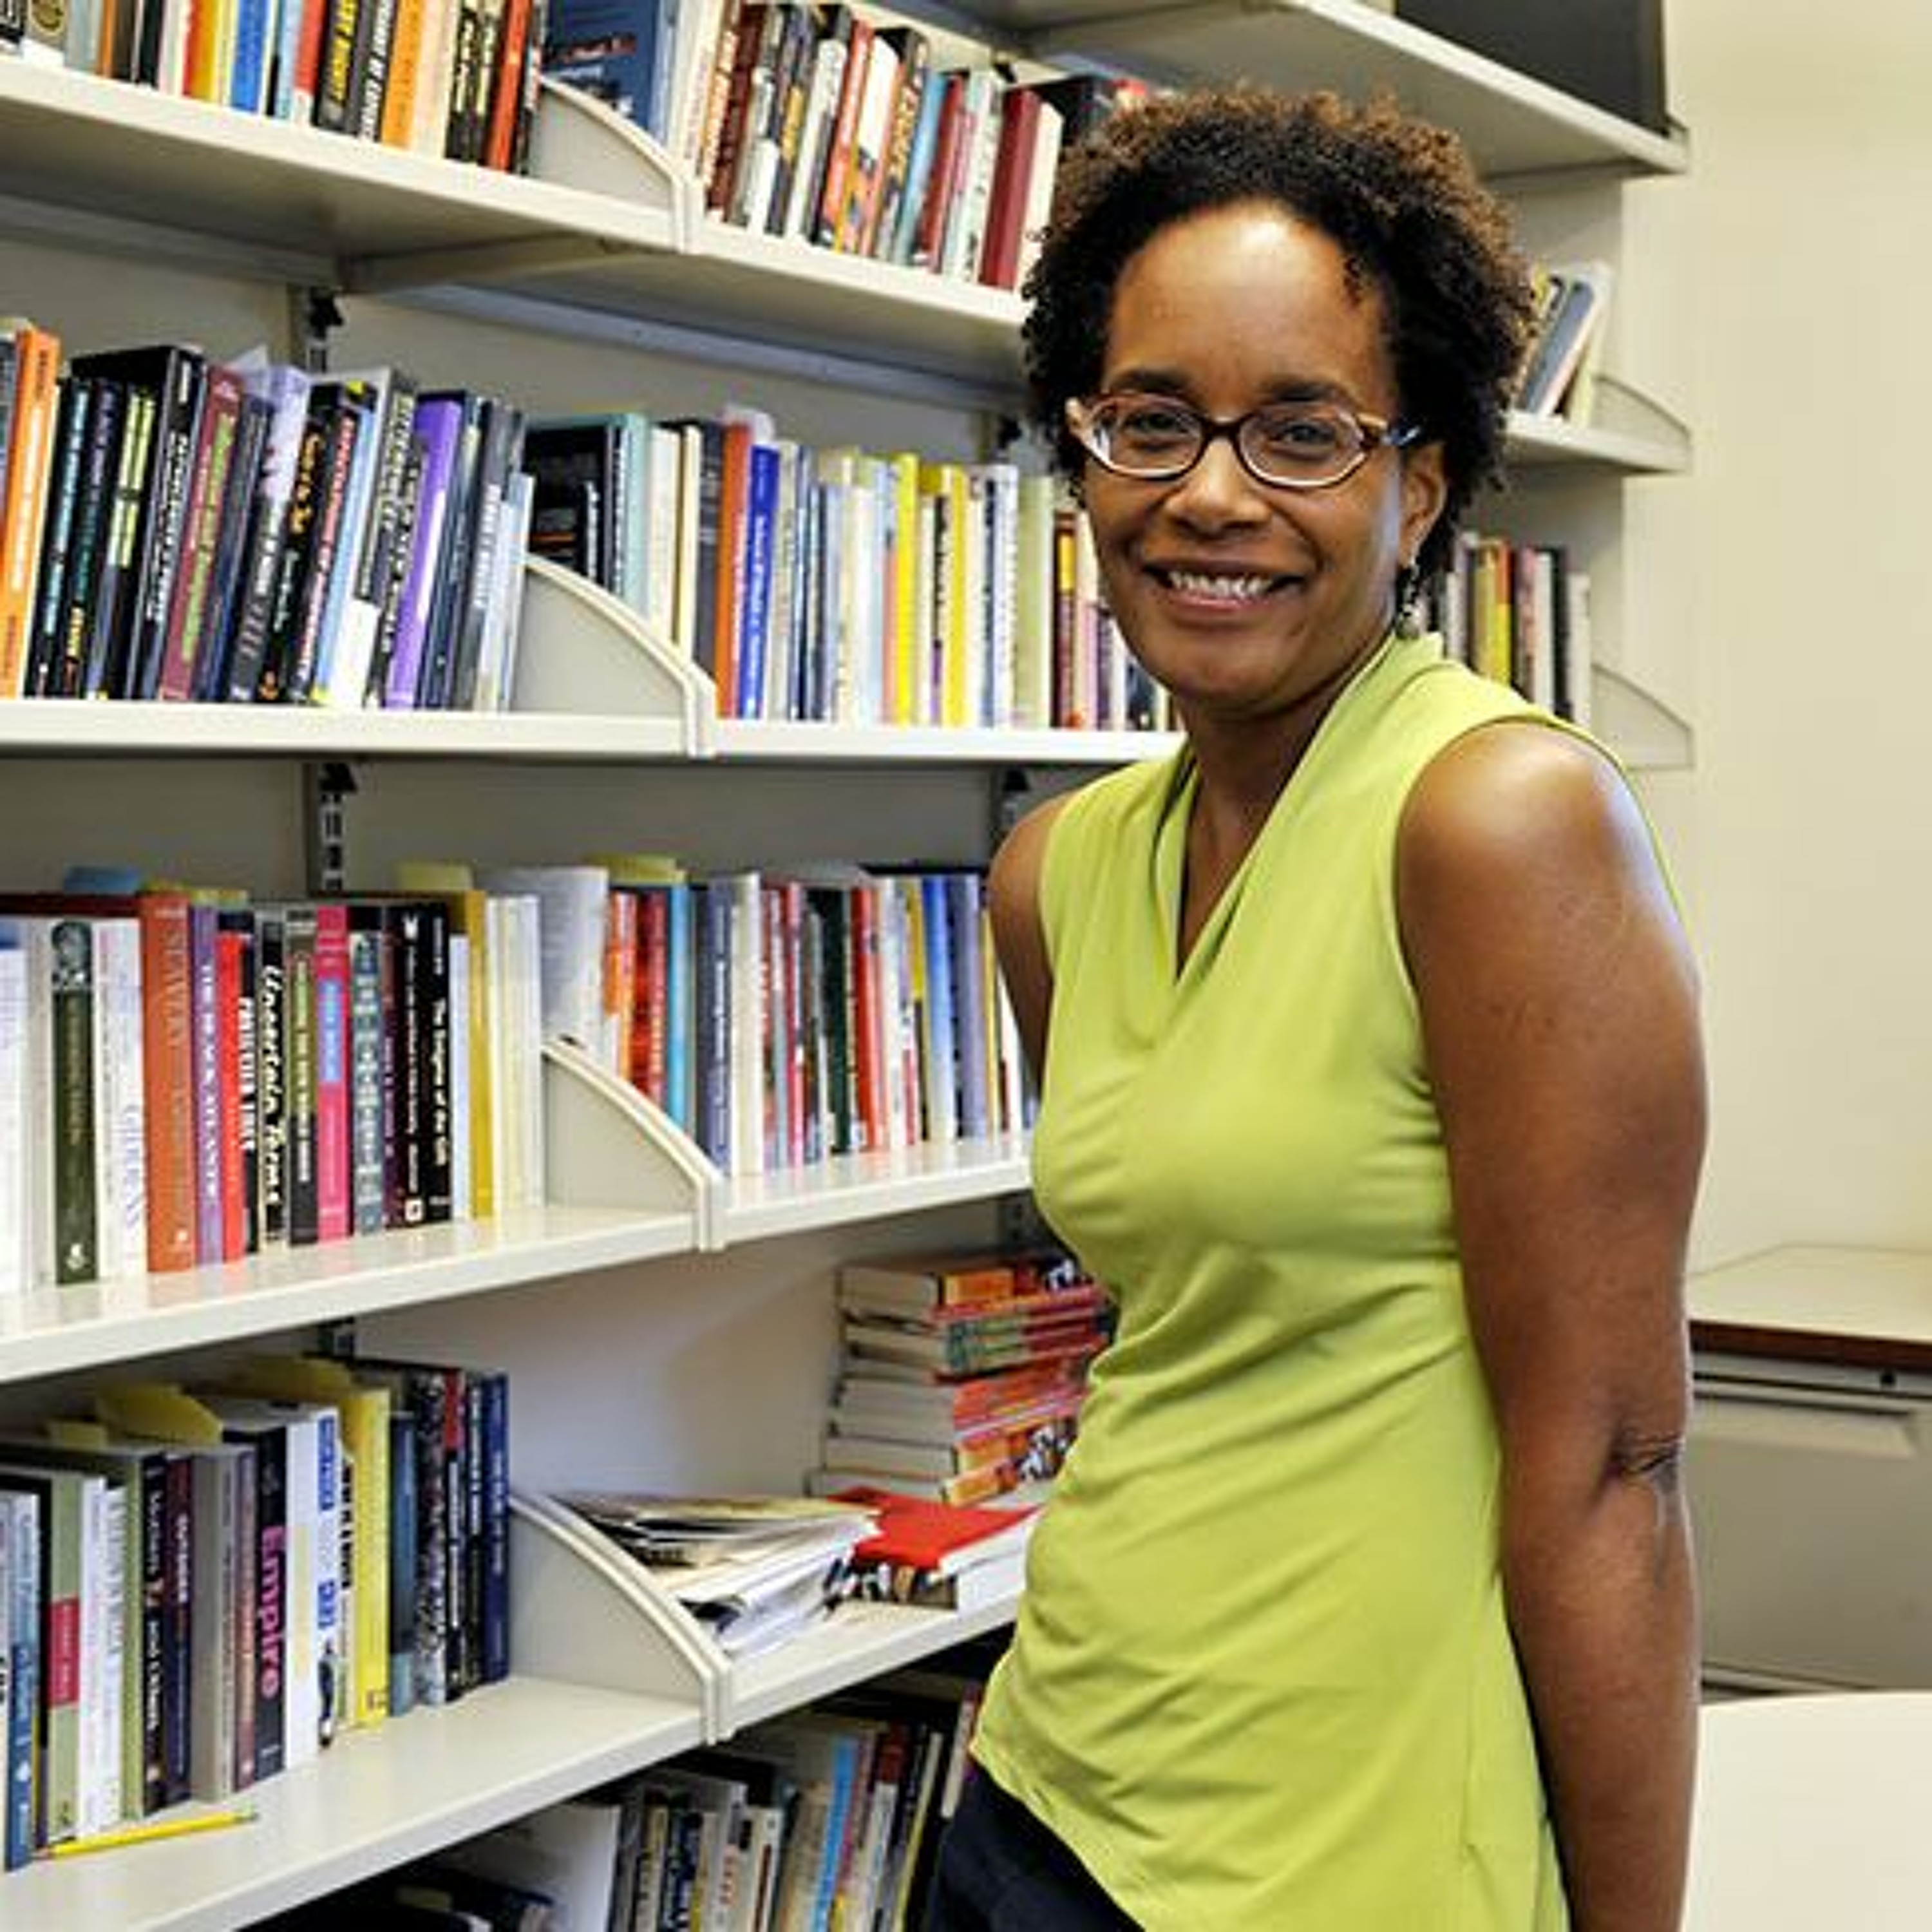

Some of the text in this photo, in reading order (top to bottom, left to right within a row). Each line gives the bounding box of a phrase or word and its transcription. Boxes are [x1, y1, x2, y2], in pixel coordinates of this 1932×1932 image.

[431, 1030, 446, 1086] Enigma
[433, 998, 446, 1025] The
[262, 966, 285, 1205] Uncertain Terms
[257, 1526, 286, 1700] Empire
